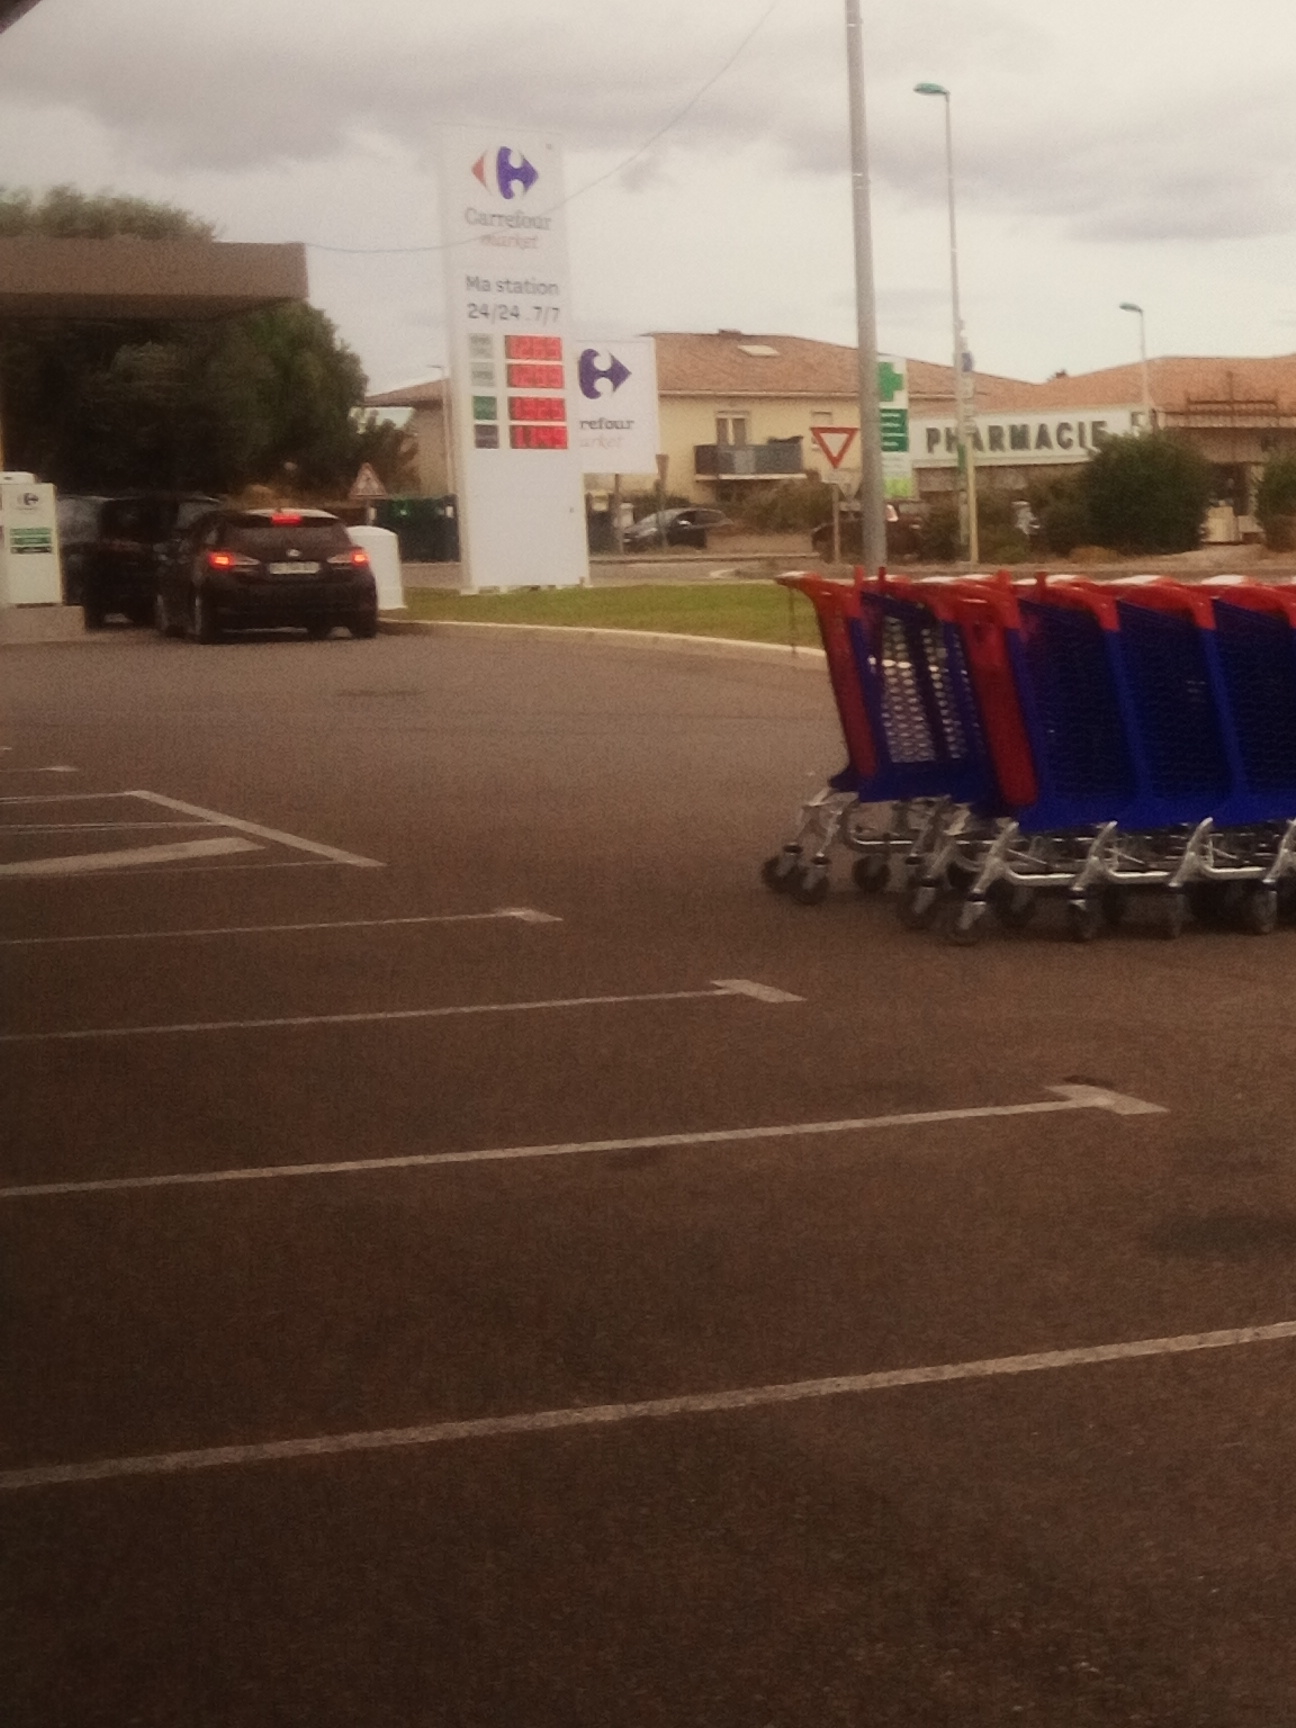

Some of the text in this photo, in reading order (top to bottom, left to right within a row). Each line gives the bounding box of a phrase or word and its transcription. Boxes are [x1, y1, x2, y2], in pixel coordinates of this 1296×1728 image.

[464, 206, 552, 231] Carrefour
[466, 275, 560, 296] Ma station
[466, 302, 521, 325] 24/24
